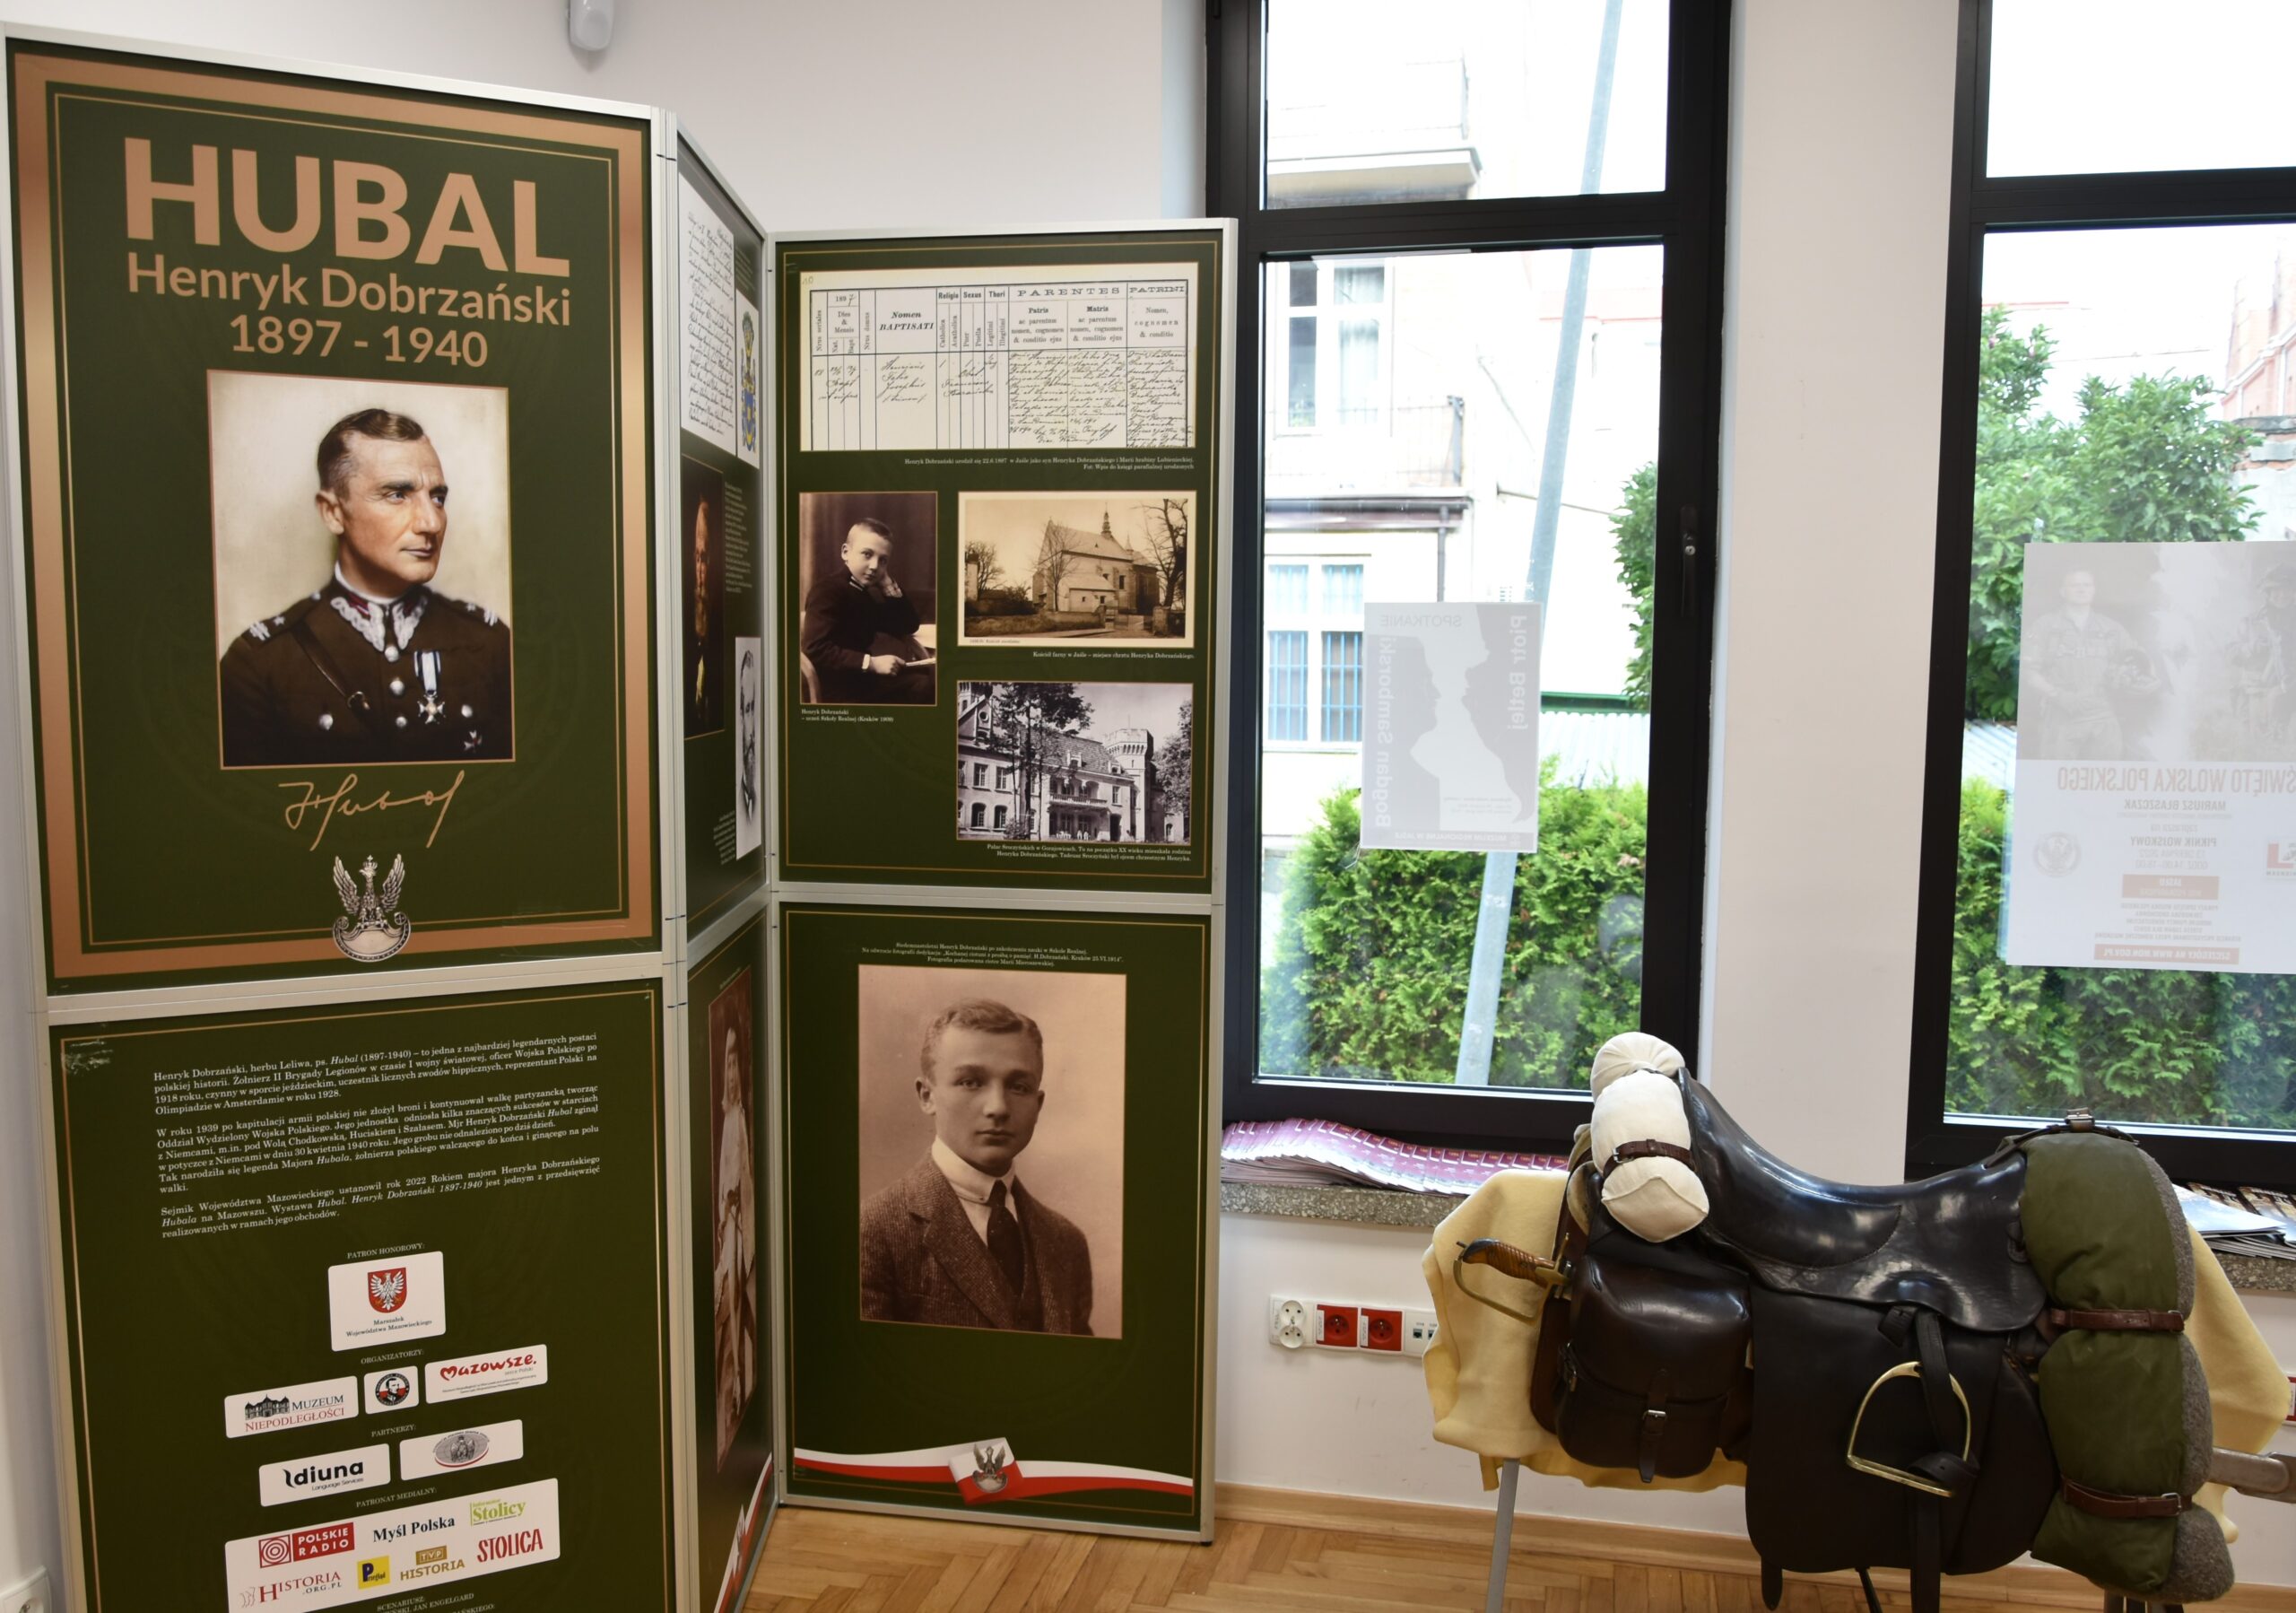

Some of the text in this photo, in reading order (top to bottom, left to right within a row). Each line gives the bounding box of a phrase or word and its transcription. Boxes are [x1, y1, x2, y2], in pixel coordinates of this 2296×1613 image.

[125, 137, 570, 277] HUBAL
[128, 252, 570, 326] Henryk Dobrzański
[1018, 287, 1120, 296] PARENTES
[879, 322, 934, 331] BAPTISATI
[230, 315, 342, 357] 1897
[383, 325, 487, 367] 1940
[153, 1069, 189, 1081] Henryk
[249, 1062, 277, 1072] herbu
[315, 1059, 328, 1068] ps.
[330, 1054, 358, 1064] Hubal
[360, 1050, 412, 1062] (1897-1940)
[430, 1045, 455, 1057] jedna
[463, 1040, 510, 1052] najbardziej
[511, 1034, 567, 1048] legendarnych
[568, 1032, 596, 1043] postaci
[153, 1081, 190, 1094] polskiej
[193, 1077, 230, 1088] historii.
[273, 1071, 281, 1081] II
[284, 1068, 322, 1080] Brygady
[325, 1065, 367, 1077] Legionów
[379, 1060, 406, 1070] czasie
[414, 1058, 440, 1068] wojny
[489, 1051, 512, 1059] oficer
[514, 1048, 544, 1058] Wojska
[546, 1044, 586, 1056] Polskiego
[587, 1044, 597, 1052] po
[154, 1102, 213, 1114] Olimpiadzie
[222, 1094, 284, 1108] Amsterdamie
[294, 1092, 316, 1101] roku
[317, 1089, 341, 1098] 1928.
[159, 1182, 188, 1193] walki.
[161, 1155, 600, 1216] Sejmik Województwa Mazowieckiego ustanowił rok 2022 Rokiem majora Henryka Dobrzańskiego
[347, 1242, 425, 1259] PATRON HONOROWY:
[361, 1349, 424, 1365] ORGANIZATORZY:
[291, 1394, 344, 1411] MUZEUM
[245, 1407, 344, 1433] NIEPODLEGŁOŚCI
[370, 1423, 416, 1438] PARTNERZY:
[356, 1494, 396, 1508] PATRONAT
[473, 1502, 526, 1521] Stolicy
[298, 1528, 348, 1546] POLSKIE
[373, 1524, 406, 1543] Myśl
[411, 1517, 455, 1534] Polska
[299, 1539, 348, 1556] RADIO
[421, 1548, 443, 1562] TVP
[477, 1529, 544, 1563] STOLICA
[400, 1559, 465, 1581] HISTORIA
[259, 1572, 341, 1603] HISTORIA
[413, 1603, 428, 1612] JAN
[430, 1592, 474, 1609] ENGELGARD
